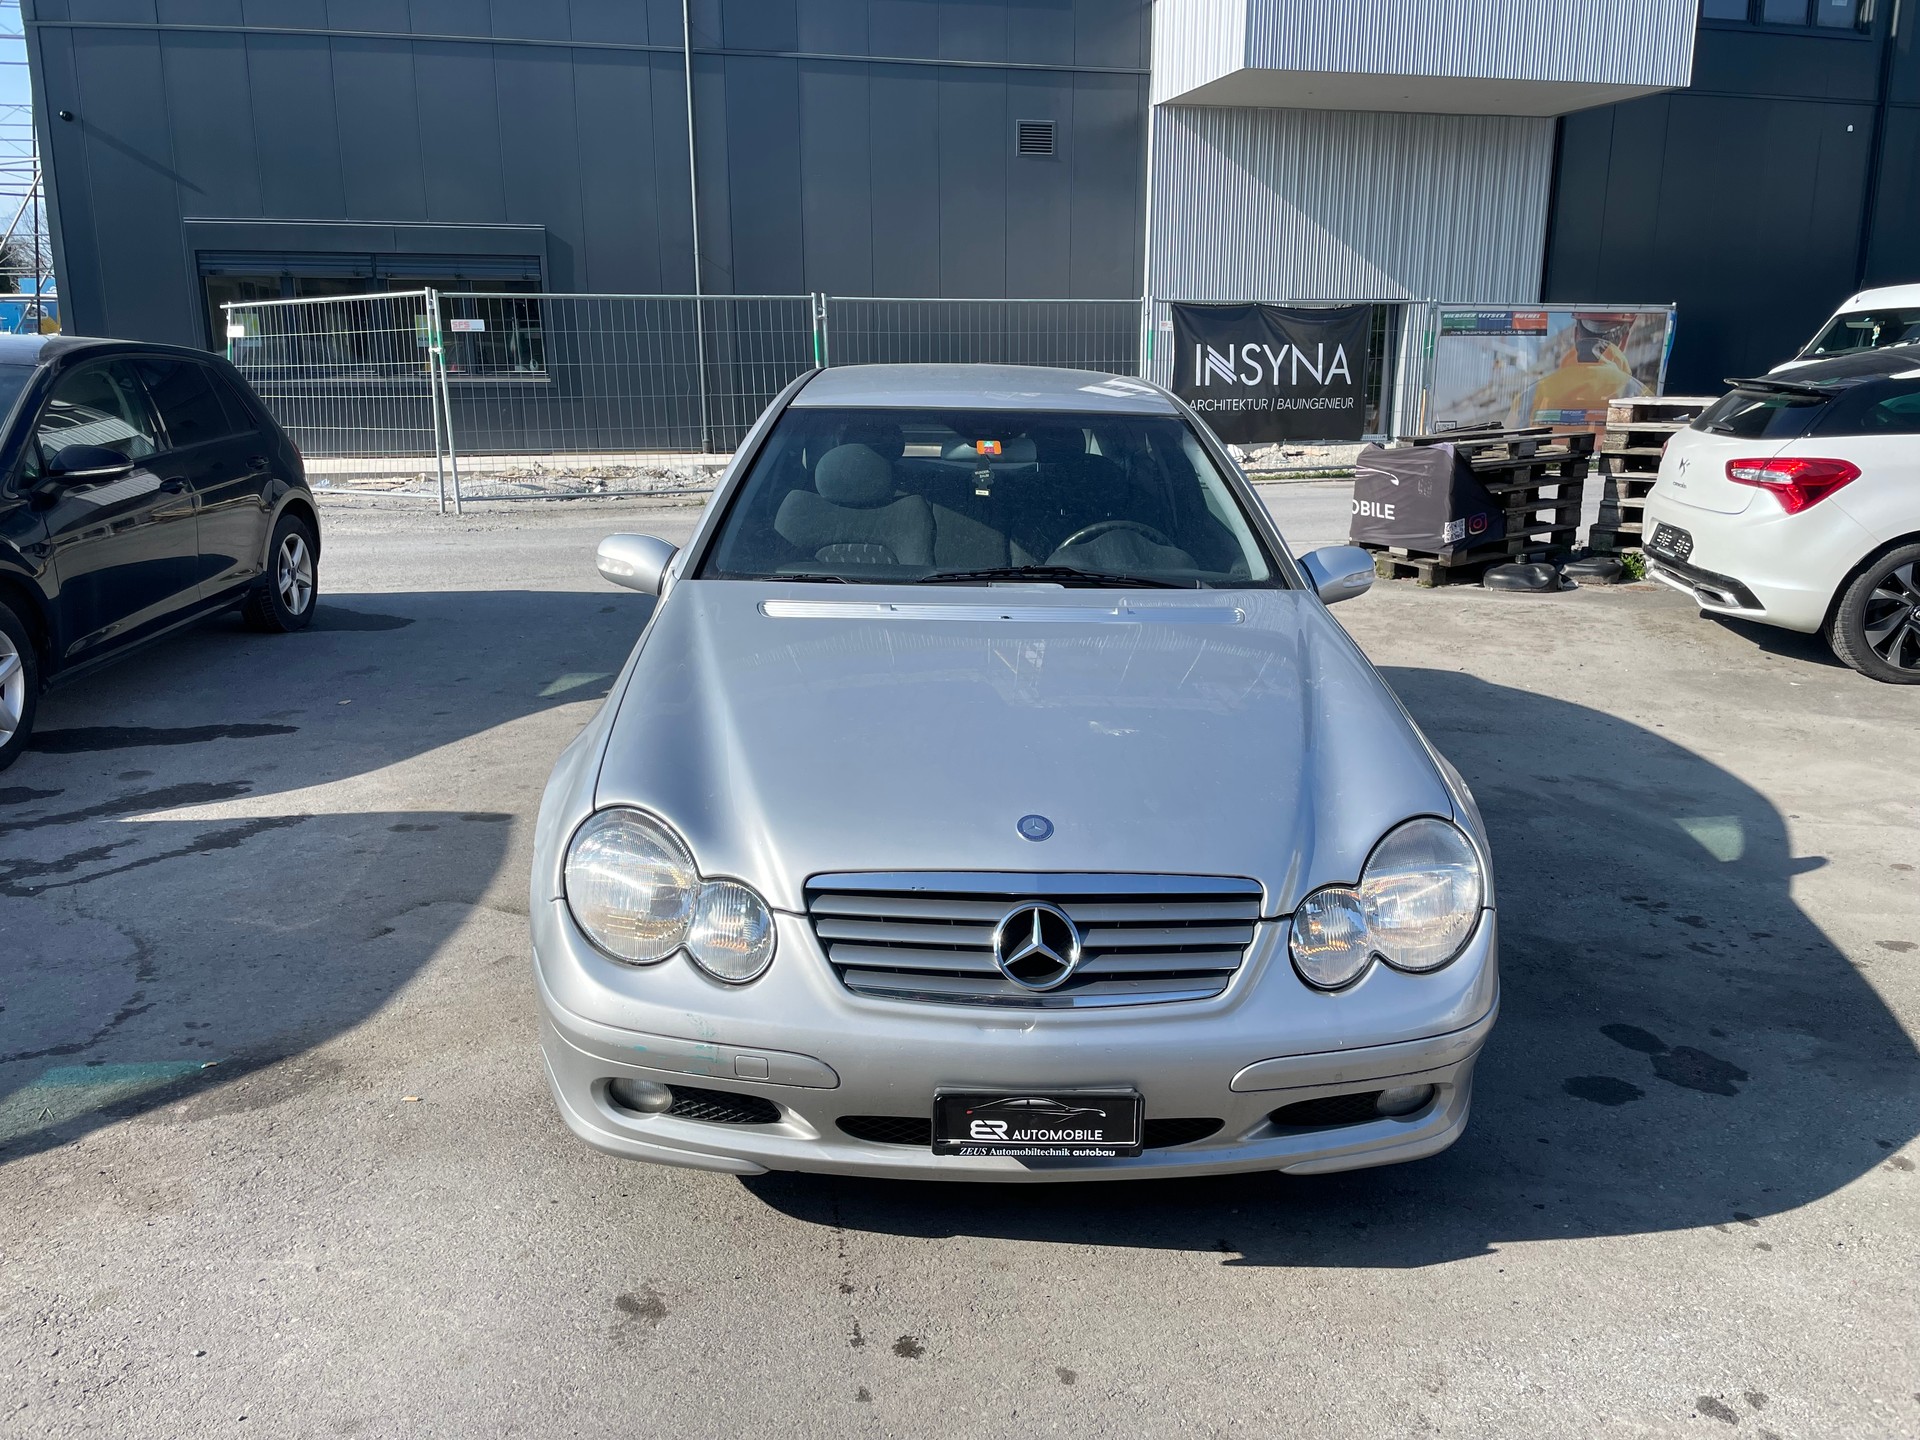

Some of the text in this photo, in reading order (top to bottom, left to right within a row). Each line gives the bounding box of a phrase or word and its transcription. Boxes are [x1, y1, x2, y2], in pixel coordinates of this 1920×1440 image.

[1195, 343, 1352, 386] INSYNA
[1189, 399, 1268, 411] ARCHITEKTUR
[1276, 397, 1354, 410] BAUINGENIEUR
[1012, 1129, 1103, 1141] AUTOMOBILE
[959, 1147, 1116, 1157] ZEUS Automobiltechnik autobau
